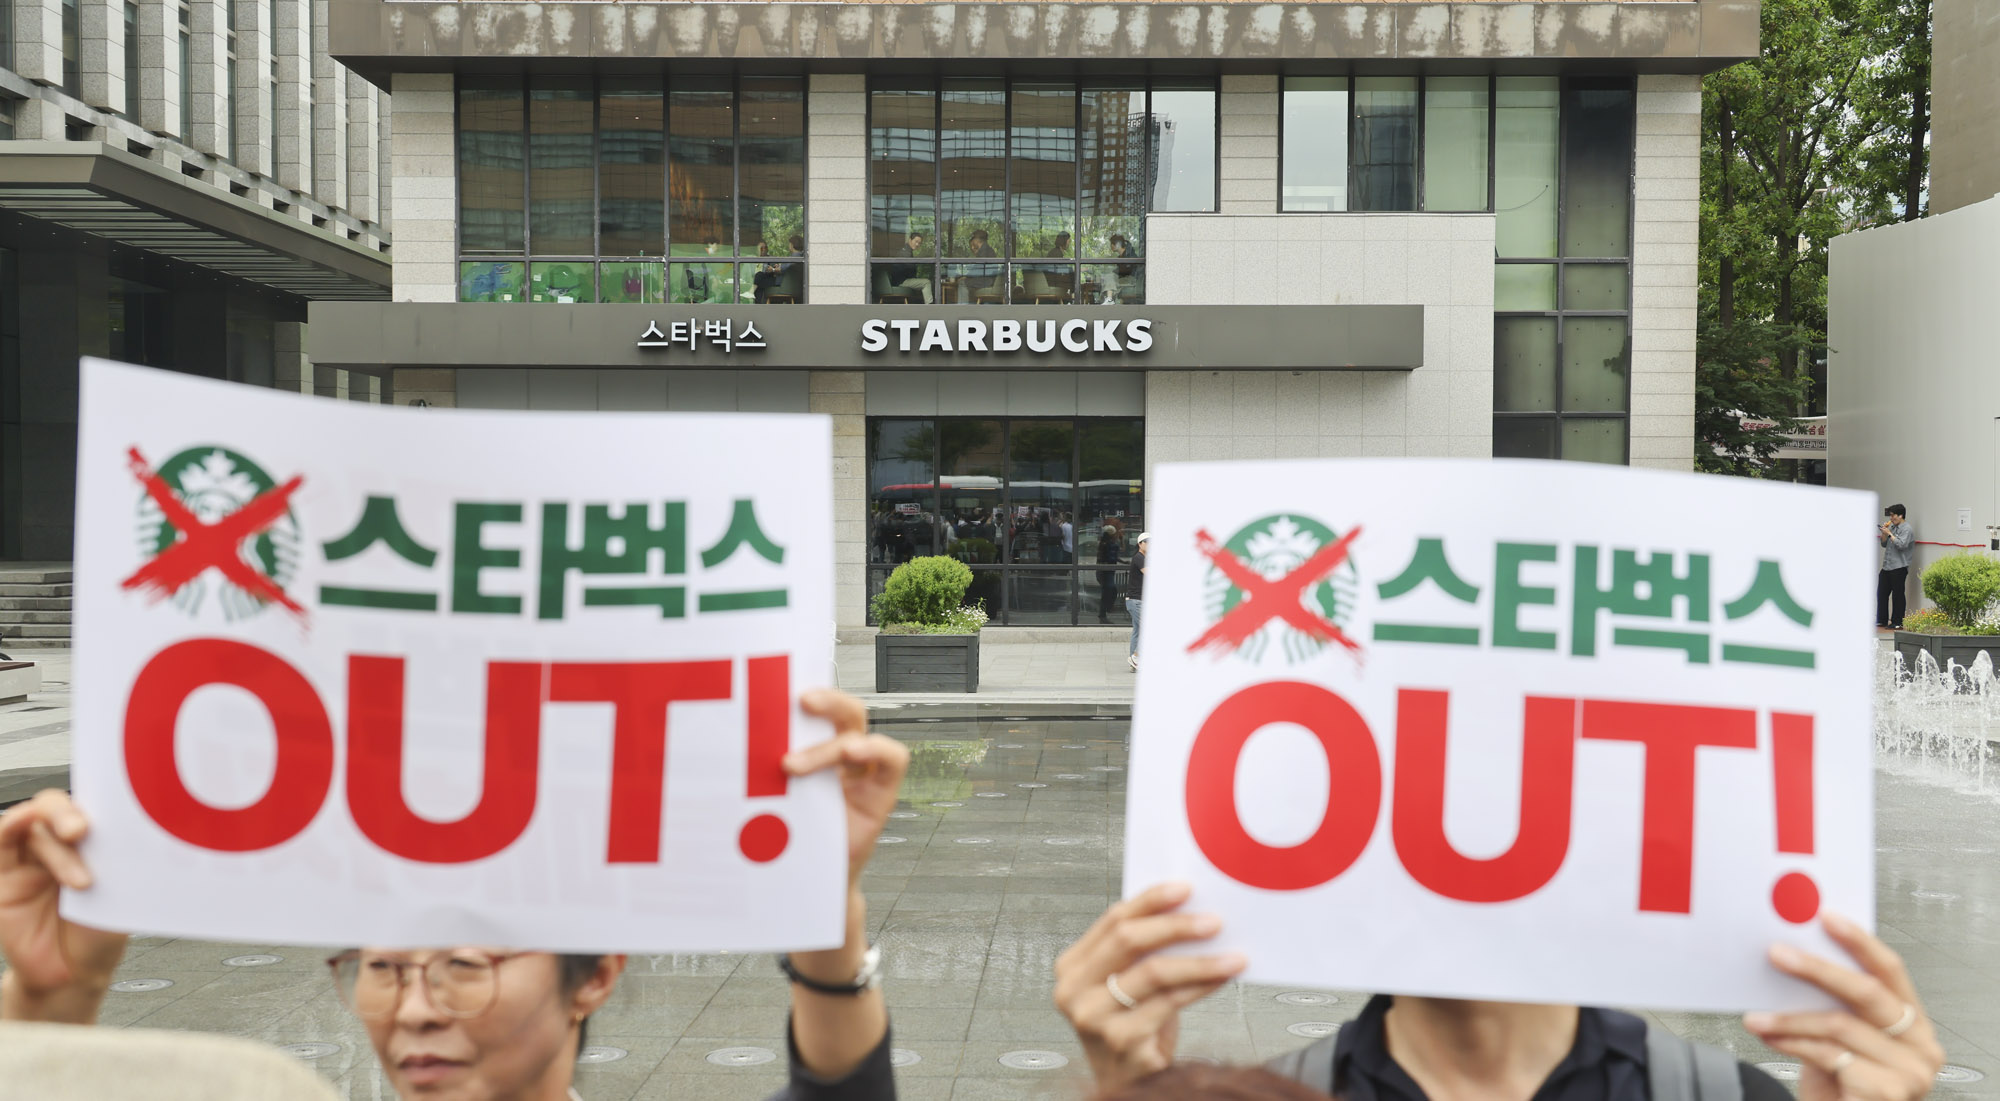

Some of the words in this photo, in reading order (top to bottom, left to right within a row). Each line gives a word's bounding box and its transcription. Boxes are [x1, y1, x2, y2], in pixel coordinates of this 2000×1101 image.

[637, 318, 767, 352] 스타벅스
[861, 318, 1153, 353] STARBUCKS
[319, 494, 789, 620] 스타벅스
[1372, 538, 1816, 669] 스타벅스
[123, 637, 791, 864] OUT!
[1185, 680, 1820, 925] OUT!
